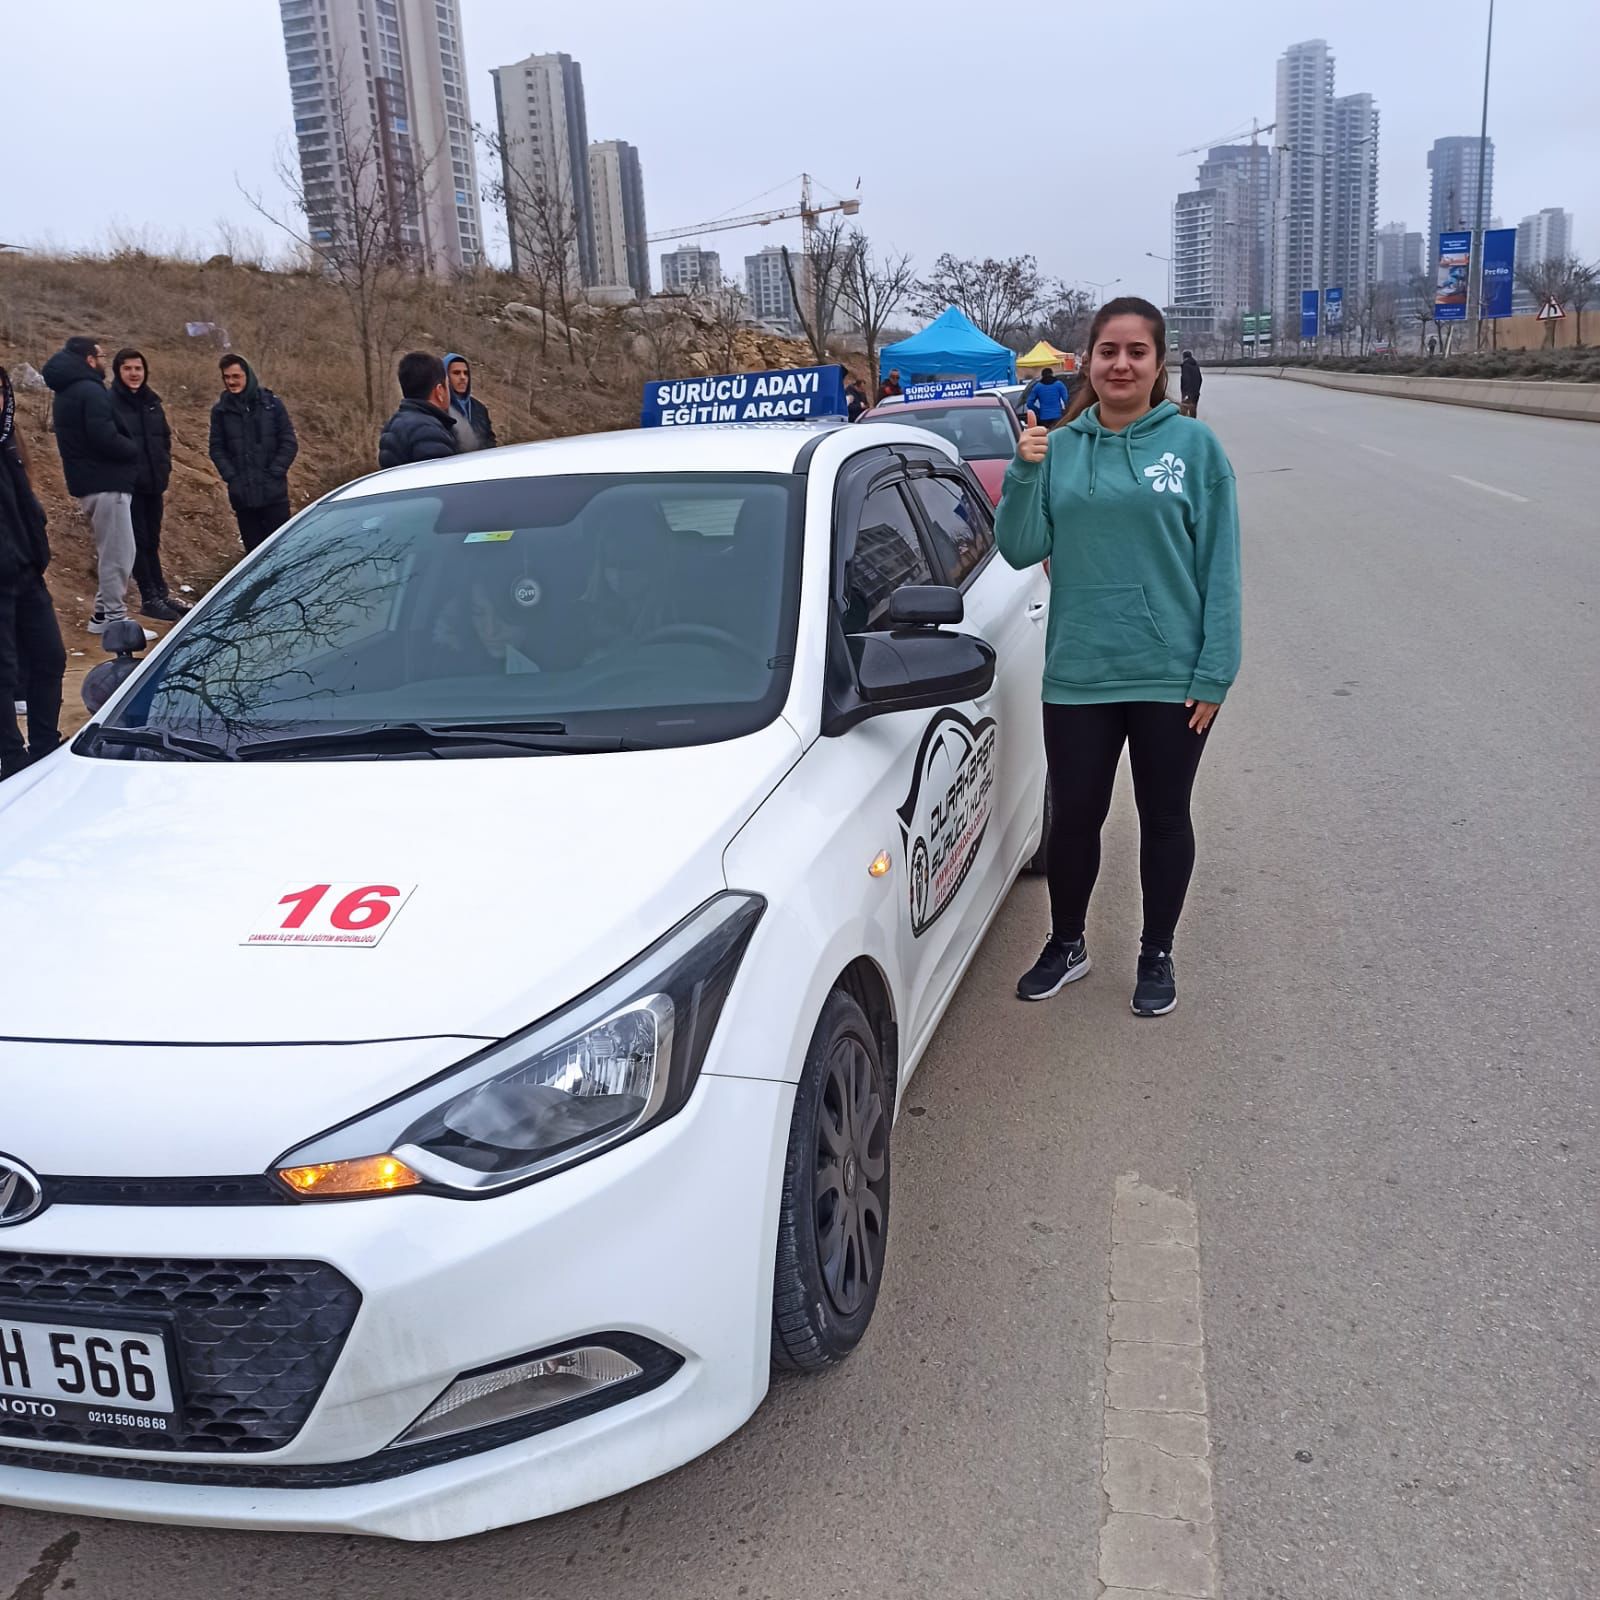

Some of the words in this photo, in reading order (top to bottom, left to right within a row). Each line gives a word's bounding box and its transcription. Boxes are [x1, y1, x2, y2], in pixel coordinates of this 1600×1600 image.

[657, 375, 747, 405] SÜRÜCÜ
[752, 372, 819, 397] ADAYI
[905, 384, 942, 395] SÜRÜCÜ
[945, 382, 972, 391] ADAYI
[941, 390, 969, 398] ARACI
[661, 402, 737, 425] EĞİTİM
[742, 398, 811, 419] ARACI
[278, 884, 401, 930] 16
[49, 1332, 156, 1402] 566
[11, 1400, 56, 1417] OTO
